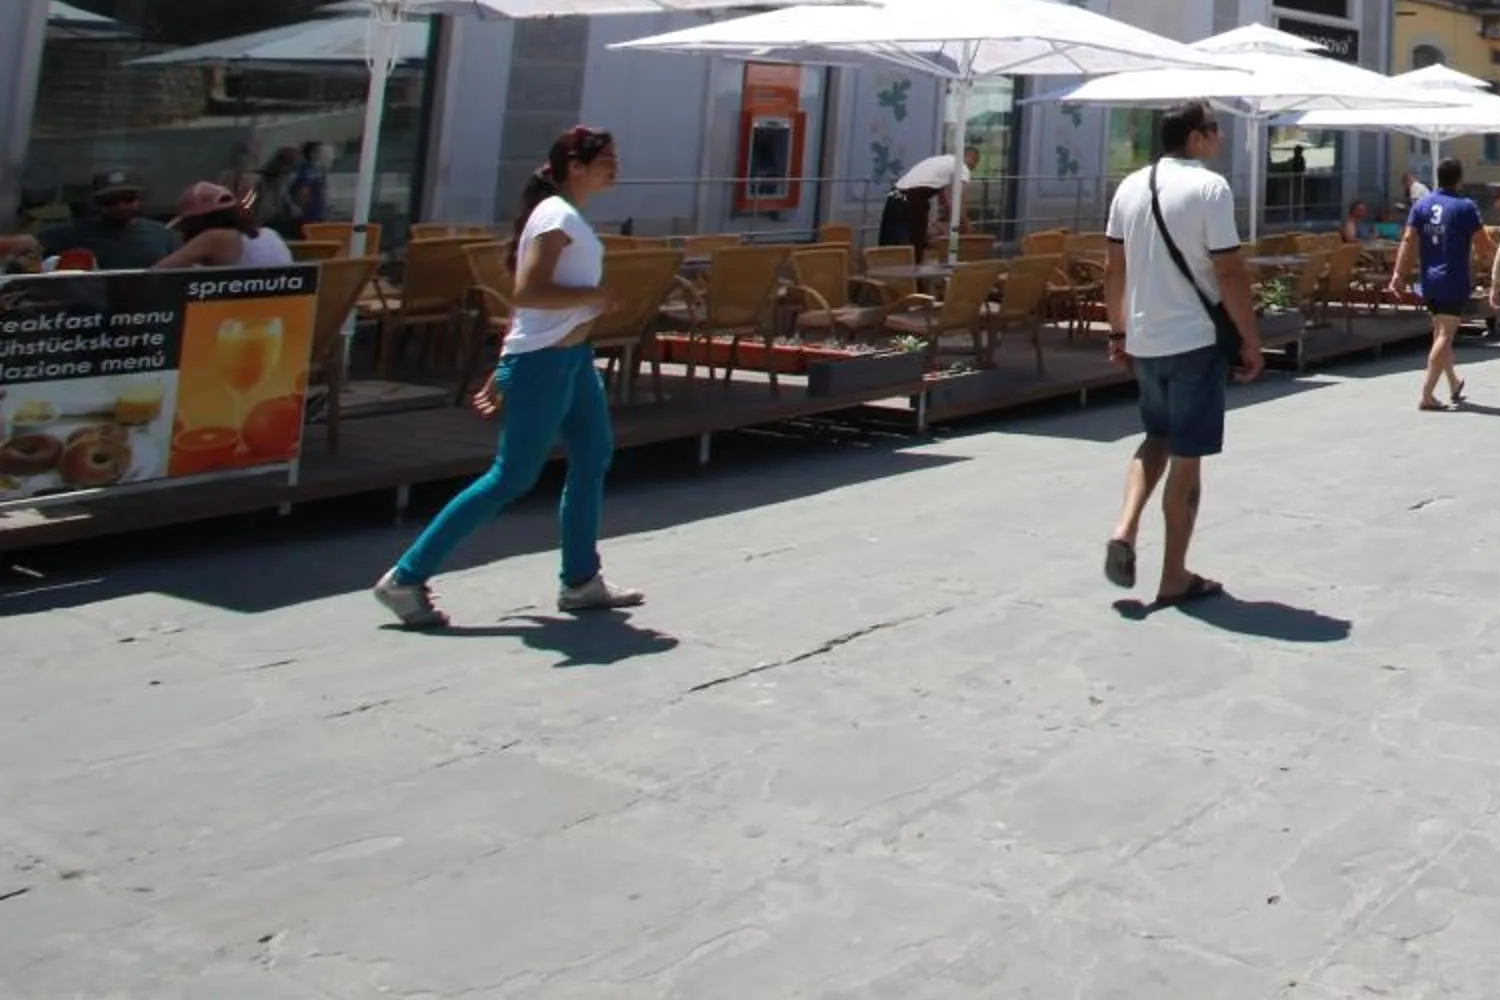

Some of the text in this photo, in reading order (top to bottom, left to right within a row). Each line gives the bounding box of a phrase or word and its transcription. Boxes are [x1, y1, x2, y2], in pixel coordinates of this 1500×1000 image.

[1430, 204, 1443, 225] 3
[187, 274, 304, 299] spremuta
[110, 309, 175, 327] menu
